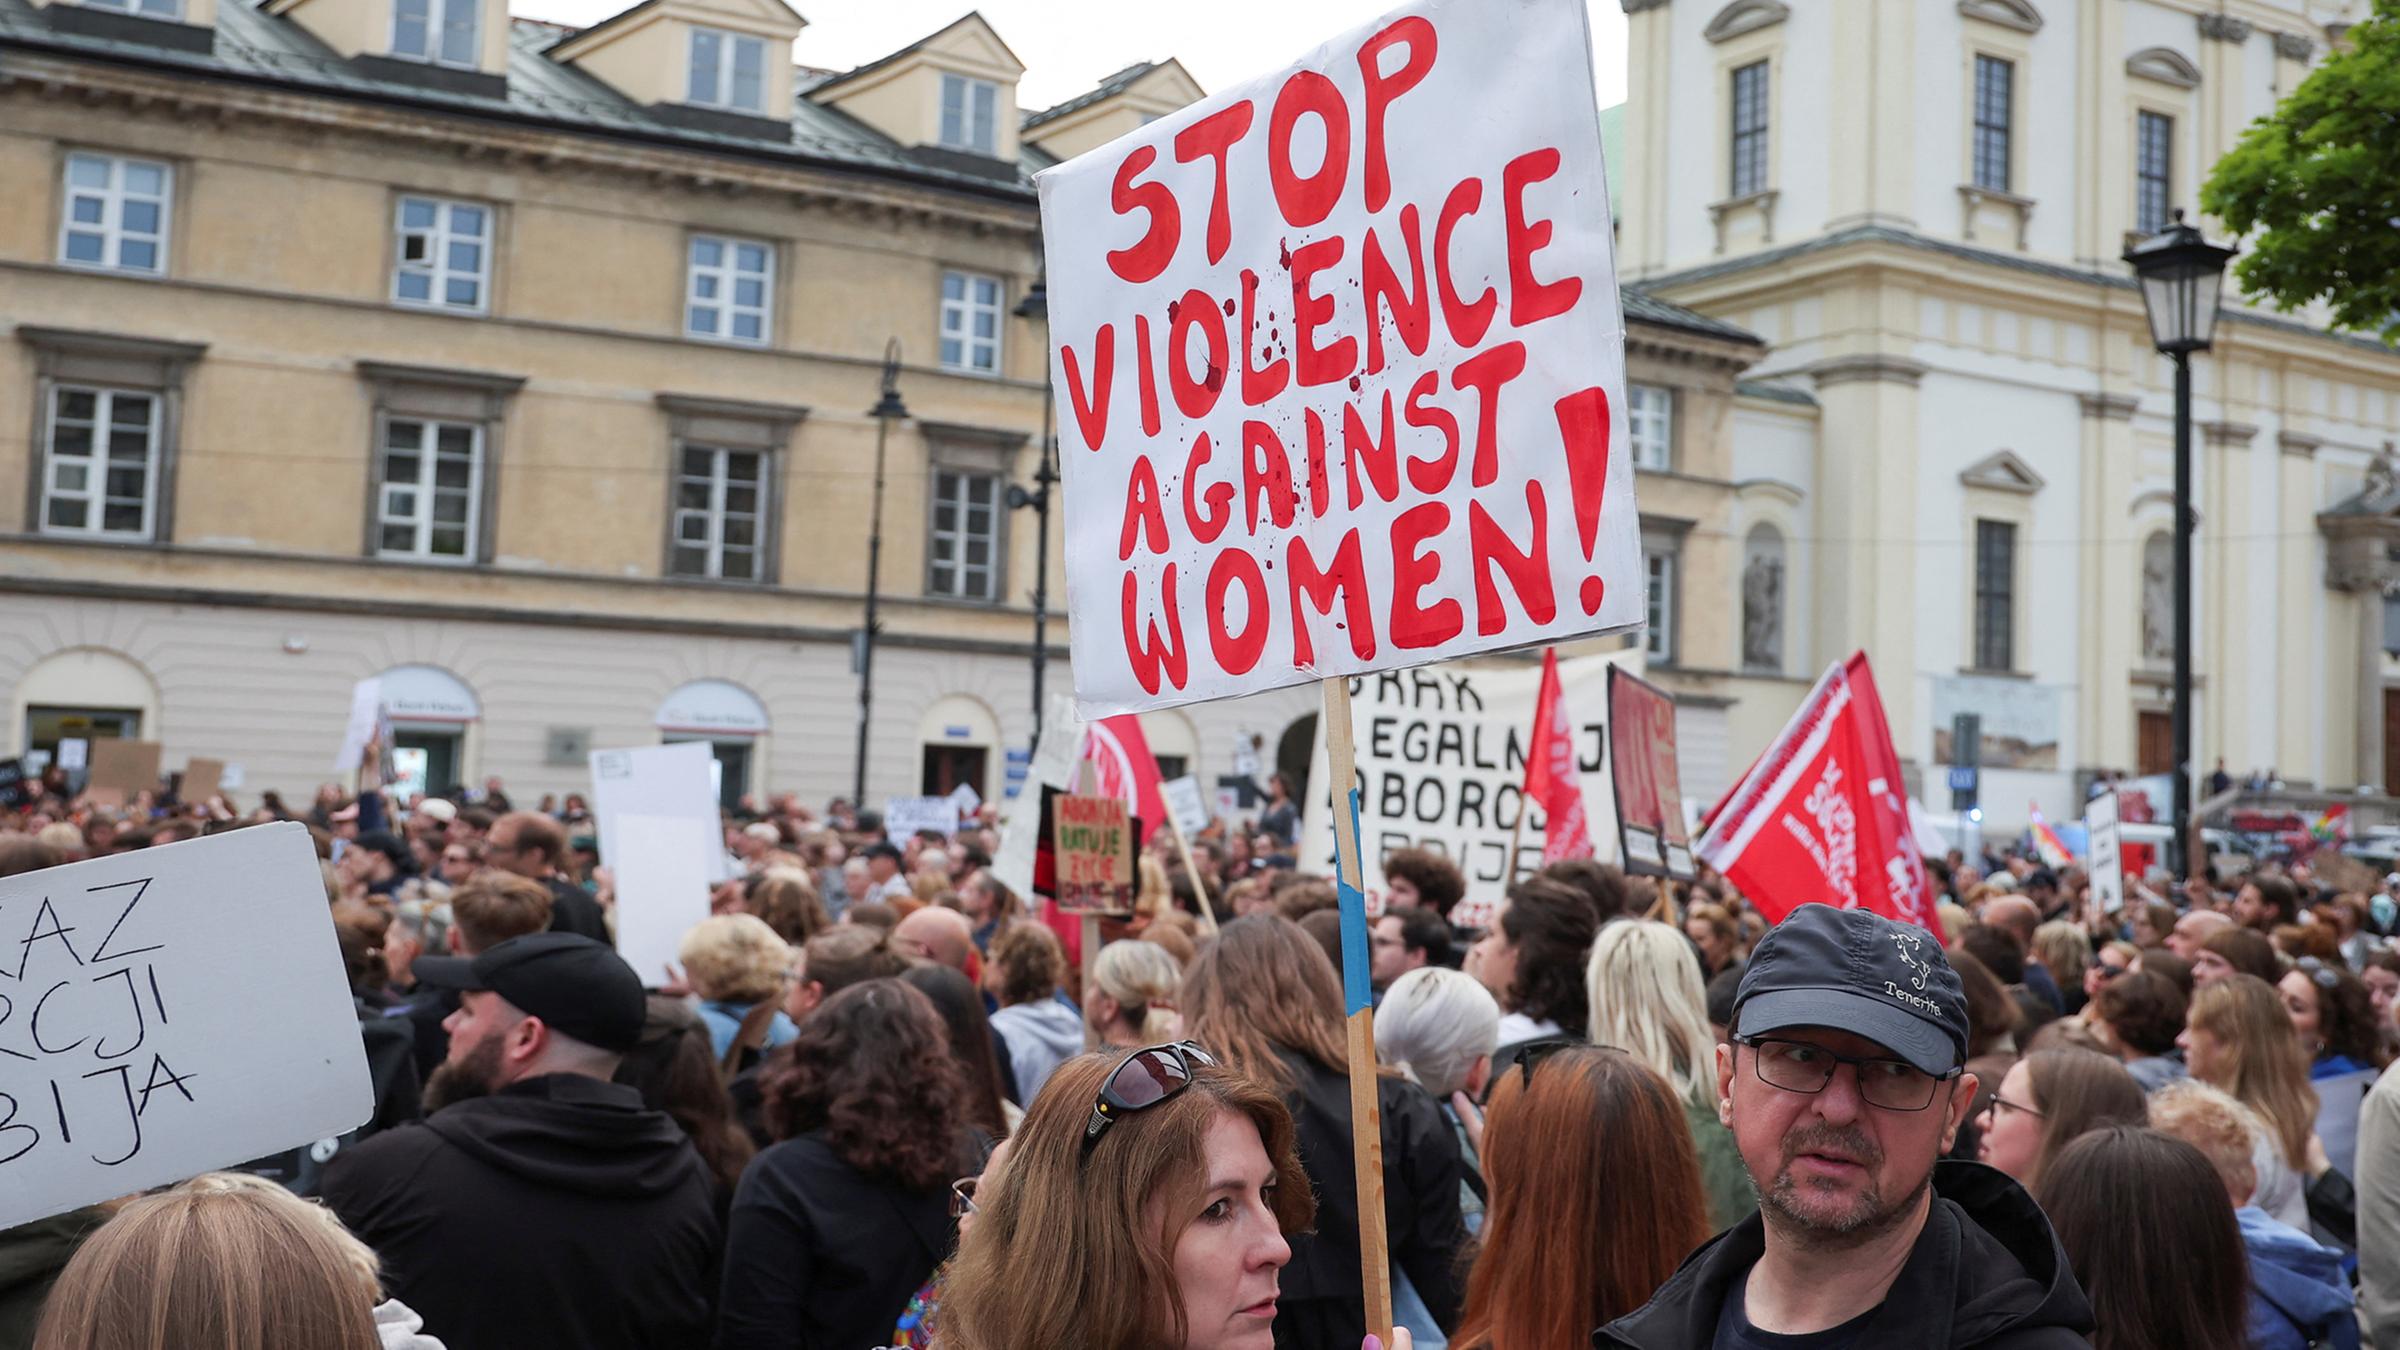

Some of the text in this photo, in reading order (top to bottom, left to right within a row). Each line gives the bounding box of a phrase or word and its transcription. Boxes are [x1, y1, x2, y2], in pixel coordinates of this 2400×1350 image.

[1106, 15, 1437, 283] STOP
[1061, 147, 1583, 451] VIOLENCE
[1119, 340, 1526, 561] AGAINST
[1122, 386, 1610, 696] WOMEN!
[1349, 670, 1483, 711] RAK
[1352, 718, 1604, 772] EGALNJ
[0, 877, 166, 982] AZ
[1884, 980, 1942, 1017] Tenerife
